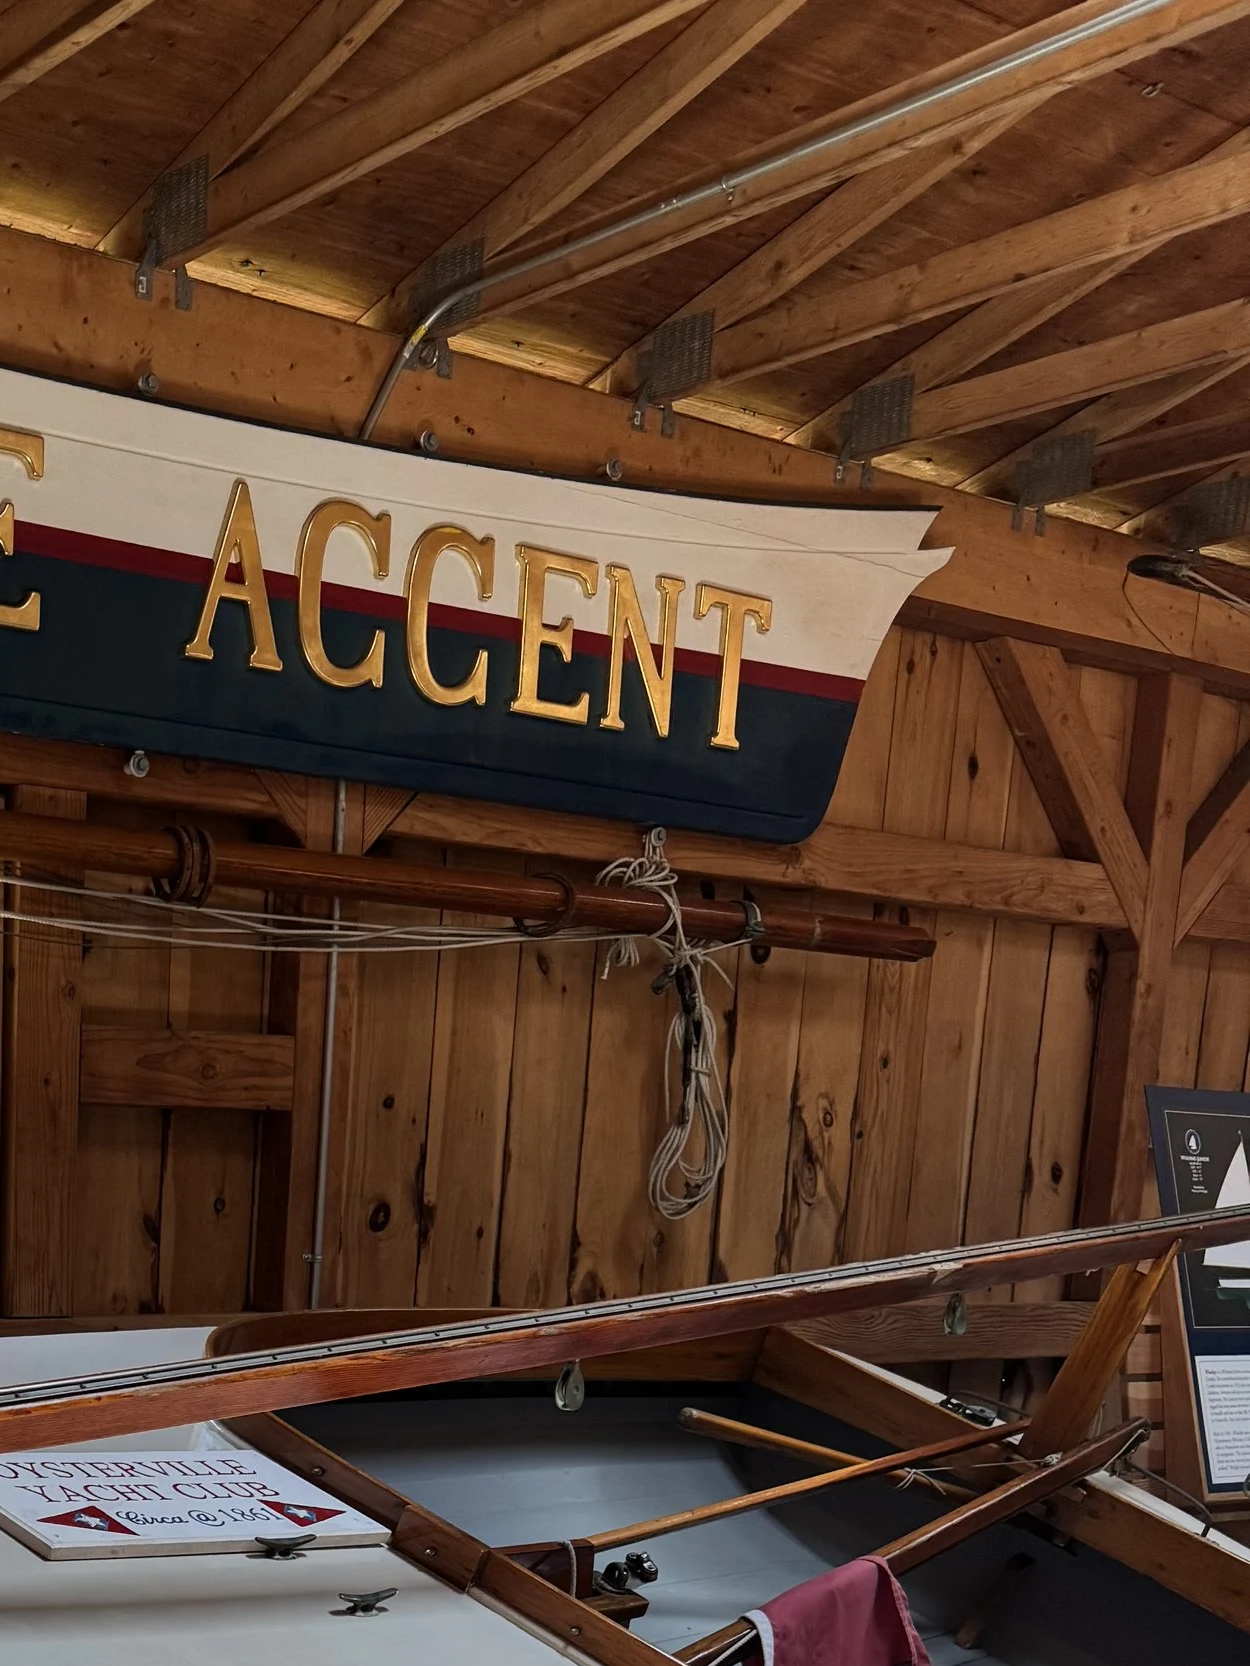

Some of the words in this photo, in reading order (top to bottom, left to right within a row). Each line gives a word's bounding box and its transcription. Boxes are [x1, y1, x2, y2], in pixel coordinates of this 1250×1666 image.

[184, 479, 773, 751] ACCENT
[15, 1483, 173, 1503] YACHT
[172, 1481, 280, 1500] CLUB
[116, 1510, 186, 1526] Circa
[190, 1509, 225, 1527] @
